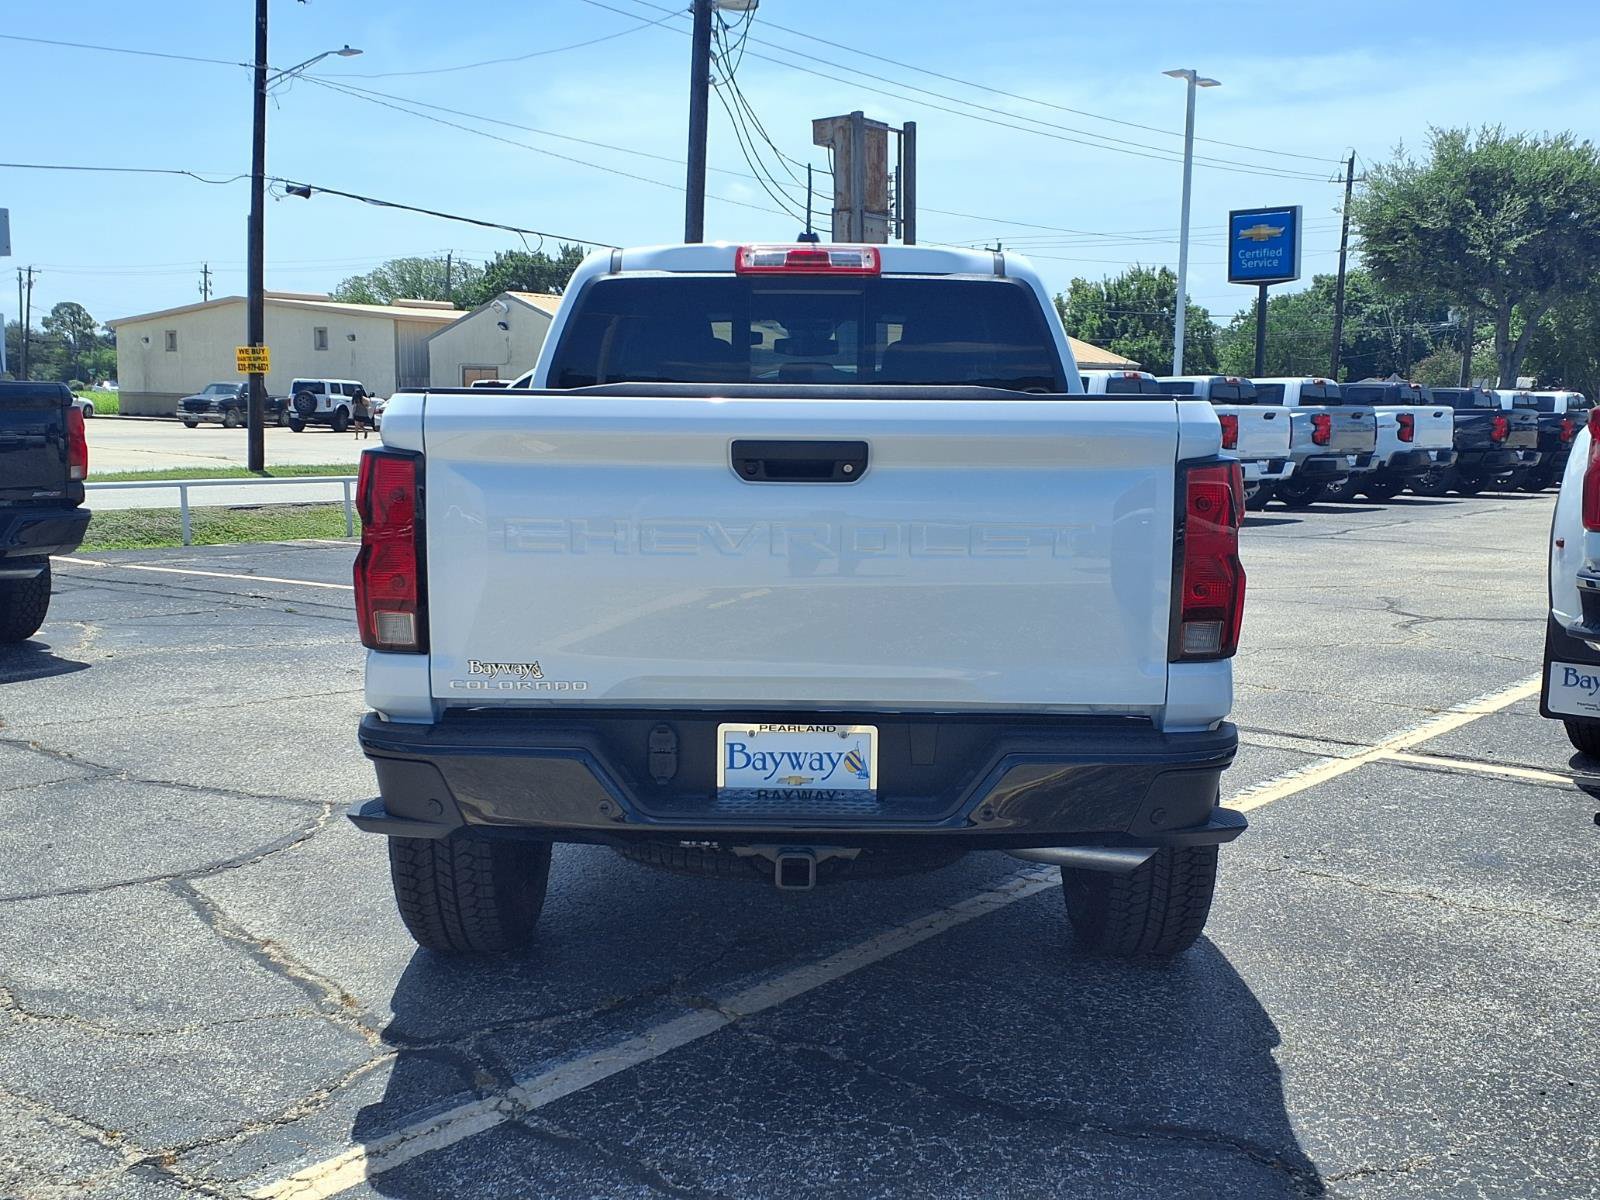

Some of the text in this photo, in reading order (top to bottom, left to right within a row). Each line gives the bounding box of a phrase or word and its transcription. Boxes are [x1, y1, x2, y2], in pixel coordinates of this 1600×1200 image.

[1238, 248, 1283, 259] Certified
[1241, 258, 1279, 268] Service
[502, 516, 1096, 557] CHEVROLET
[468, 660, 534, 680] Bayway
[449, 680, 588, 691] COLORADO
[759, 724, 837, 733] PEARLAND
[726, 742, 845, 780] Bayway
